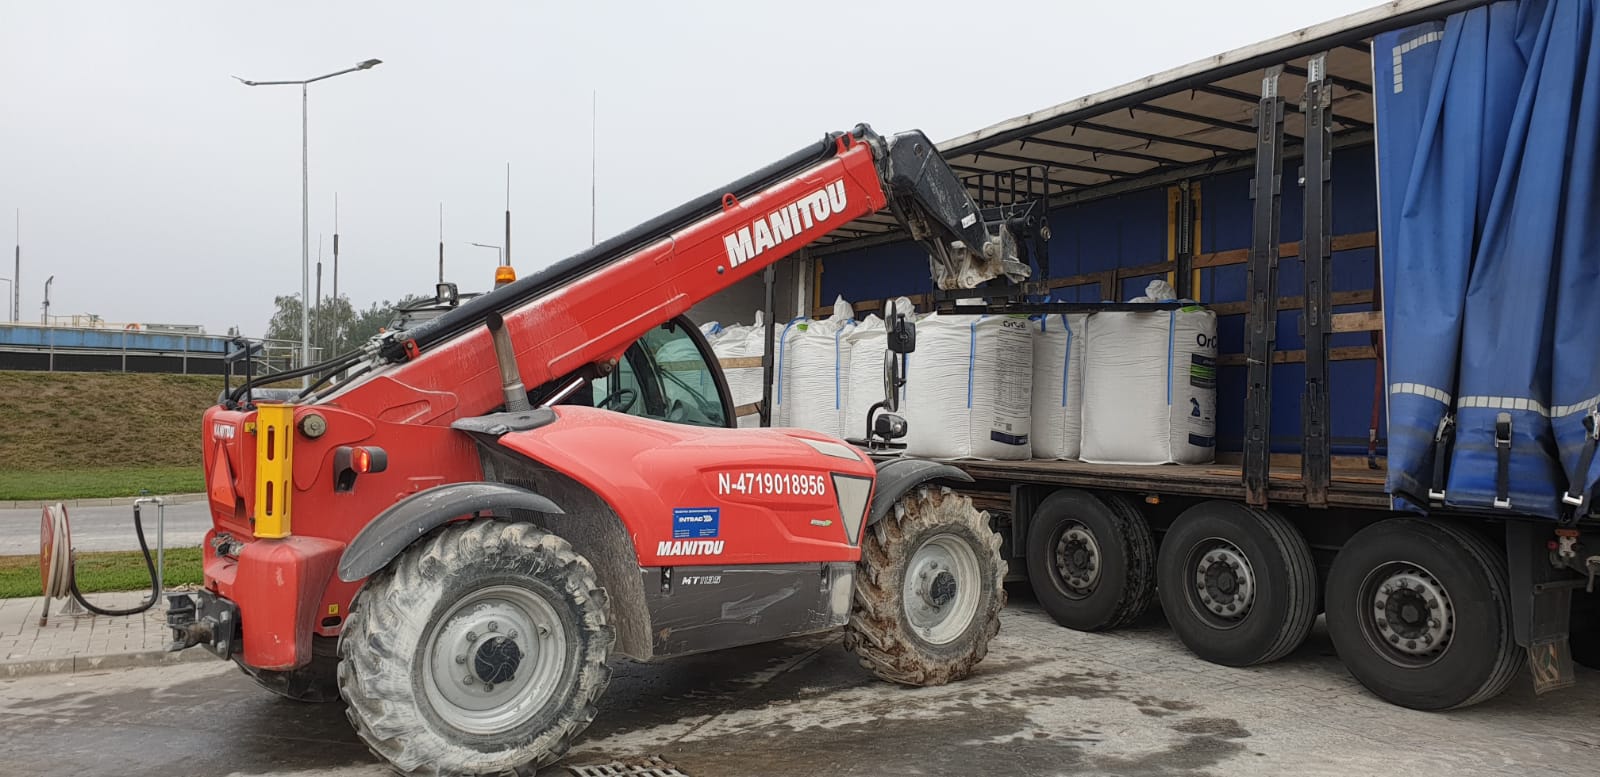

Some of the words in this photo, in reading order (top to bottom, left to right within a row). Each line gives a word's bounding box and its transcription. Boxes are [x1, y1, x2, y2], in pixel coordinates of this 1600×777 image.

[724, 179, 847, 269] MANITOU
[718, 473, 825, 496] N-4719018956
[656, 541, 725, 557] MANITOU
